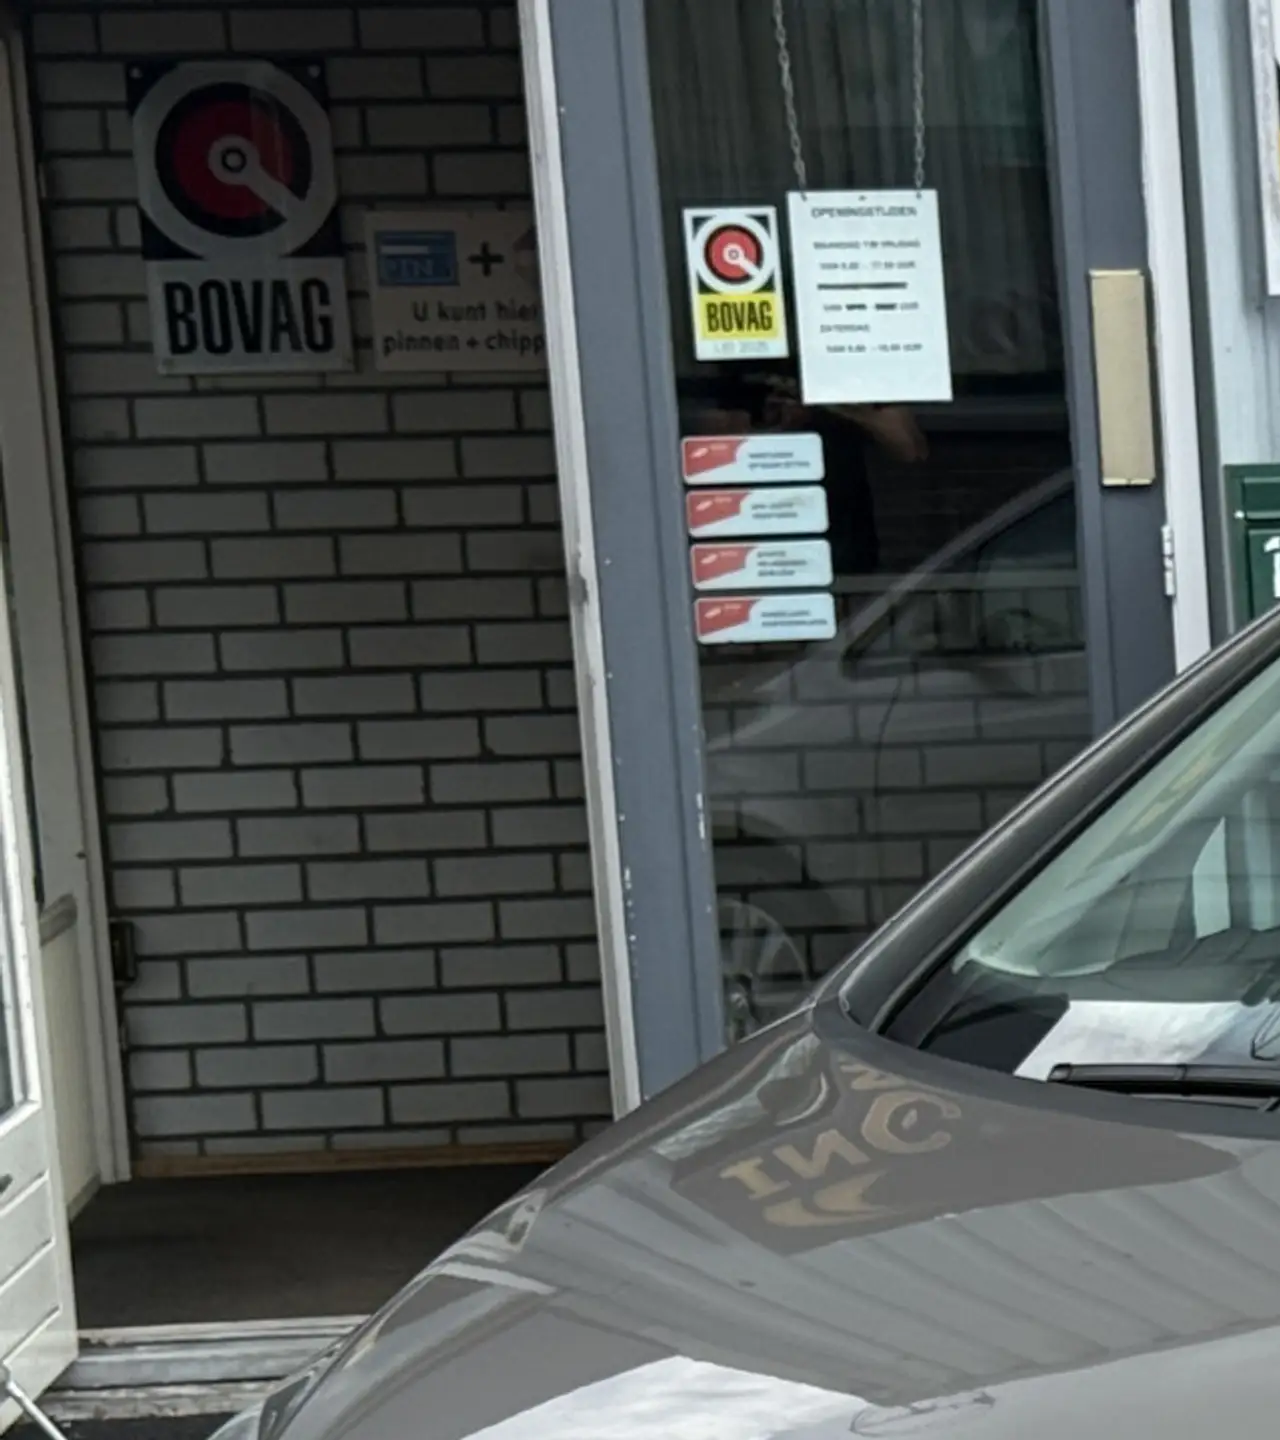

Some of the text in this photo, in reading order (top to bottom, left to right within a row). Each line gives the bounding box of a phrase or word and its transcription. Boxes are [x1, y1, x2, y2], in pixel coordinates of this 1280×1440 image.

[163, 278, 335, 357] BOVAG
[706, 300, 773, 332] BOVAG
[383, 328, 460, 357] pinnen
